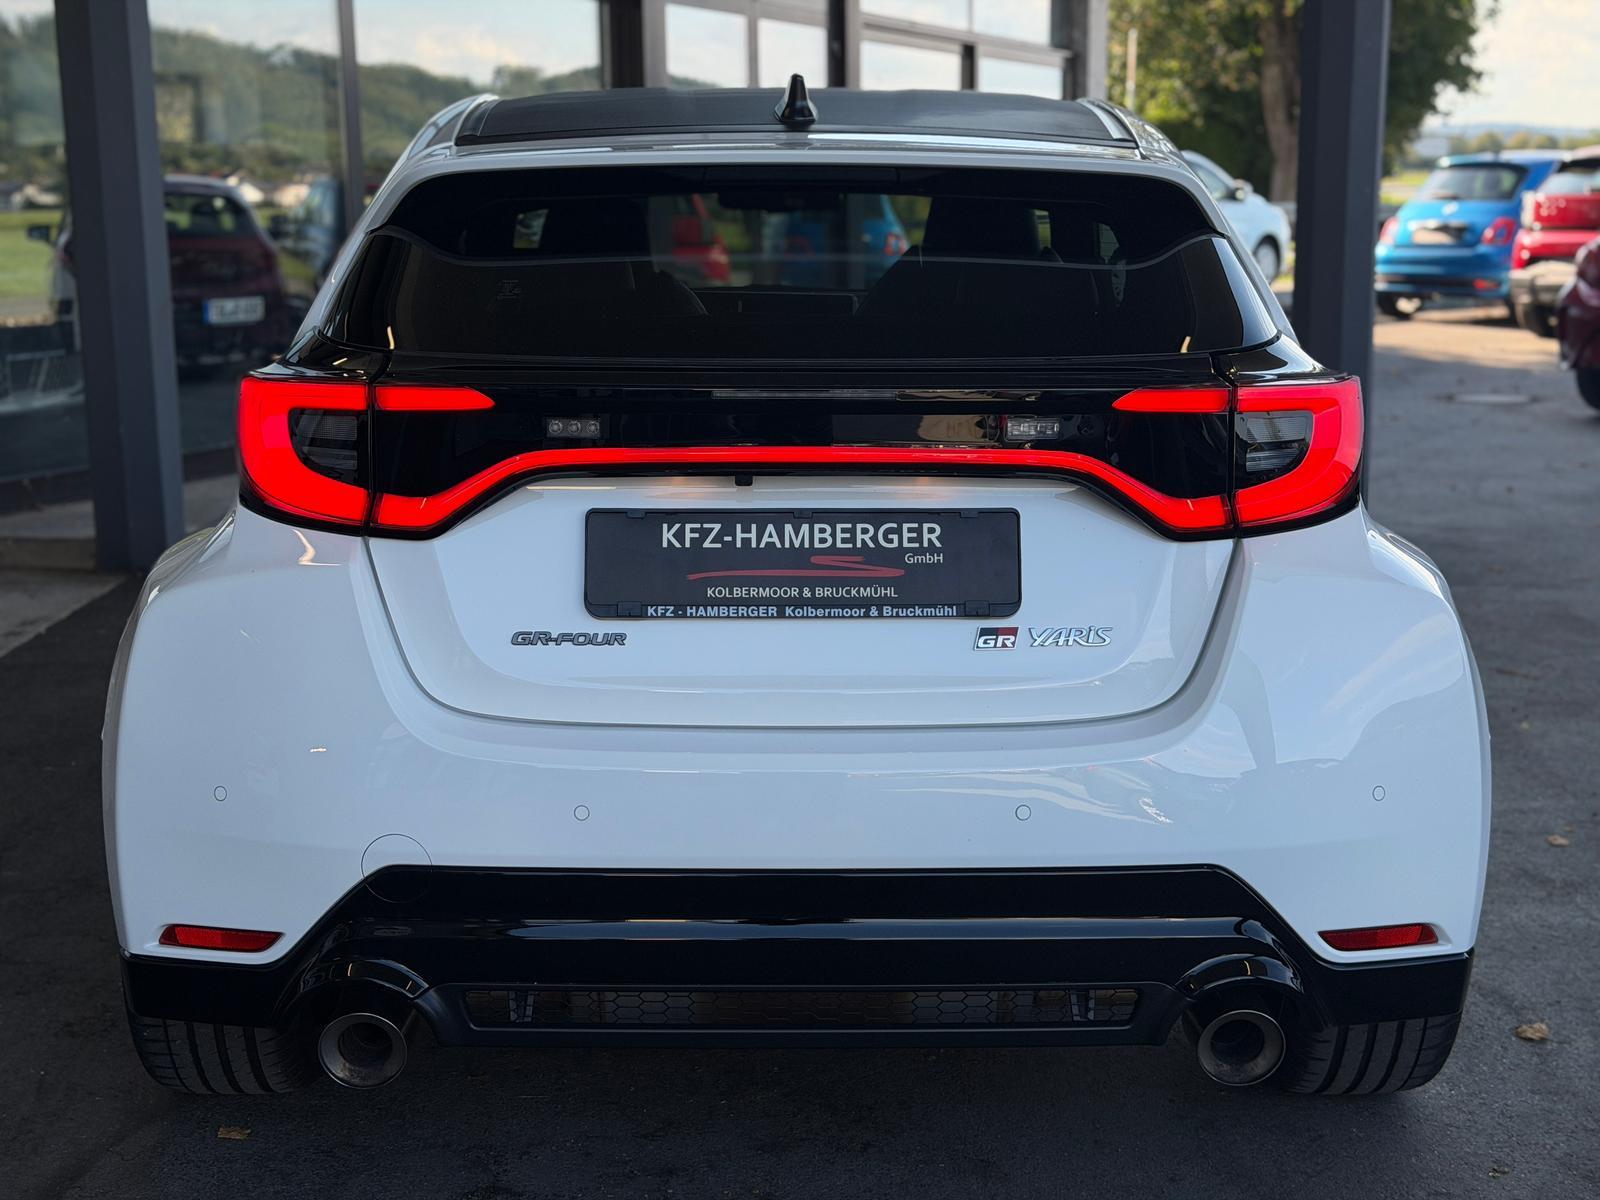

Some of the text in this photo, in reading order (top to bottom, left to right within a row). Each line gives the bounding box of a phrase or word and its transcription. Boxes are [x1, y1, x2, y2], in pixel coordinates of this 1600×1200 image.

[661, 522, 943, 548] KFZ-HAMBERGER
[904, 552, 944, 564] GmbH
[707, 584, 898, 598] KOLBERMOOR & BRUCKMÜHL
[647, 606, 675, 617] KFZ
[686, 606, 778, 617] HAMBERGER
[785, 606, 866, 617] Kolbermoor
[869, 606, 879, 617] &
[883, 606, 957, 617] Bruckmühl
[511, 630, 628, 646] GR-FOUR
[977, 635, 1016, 648] GR
